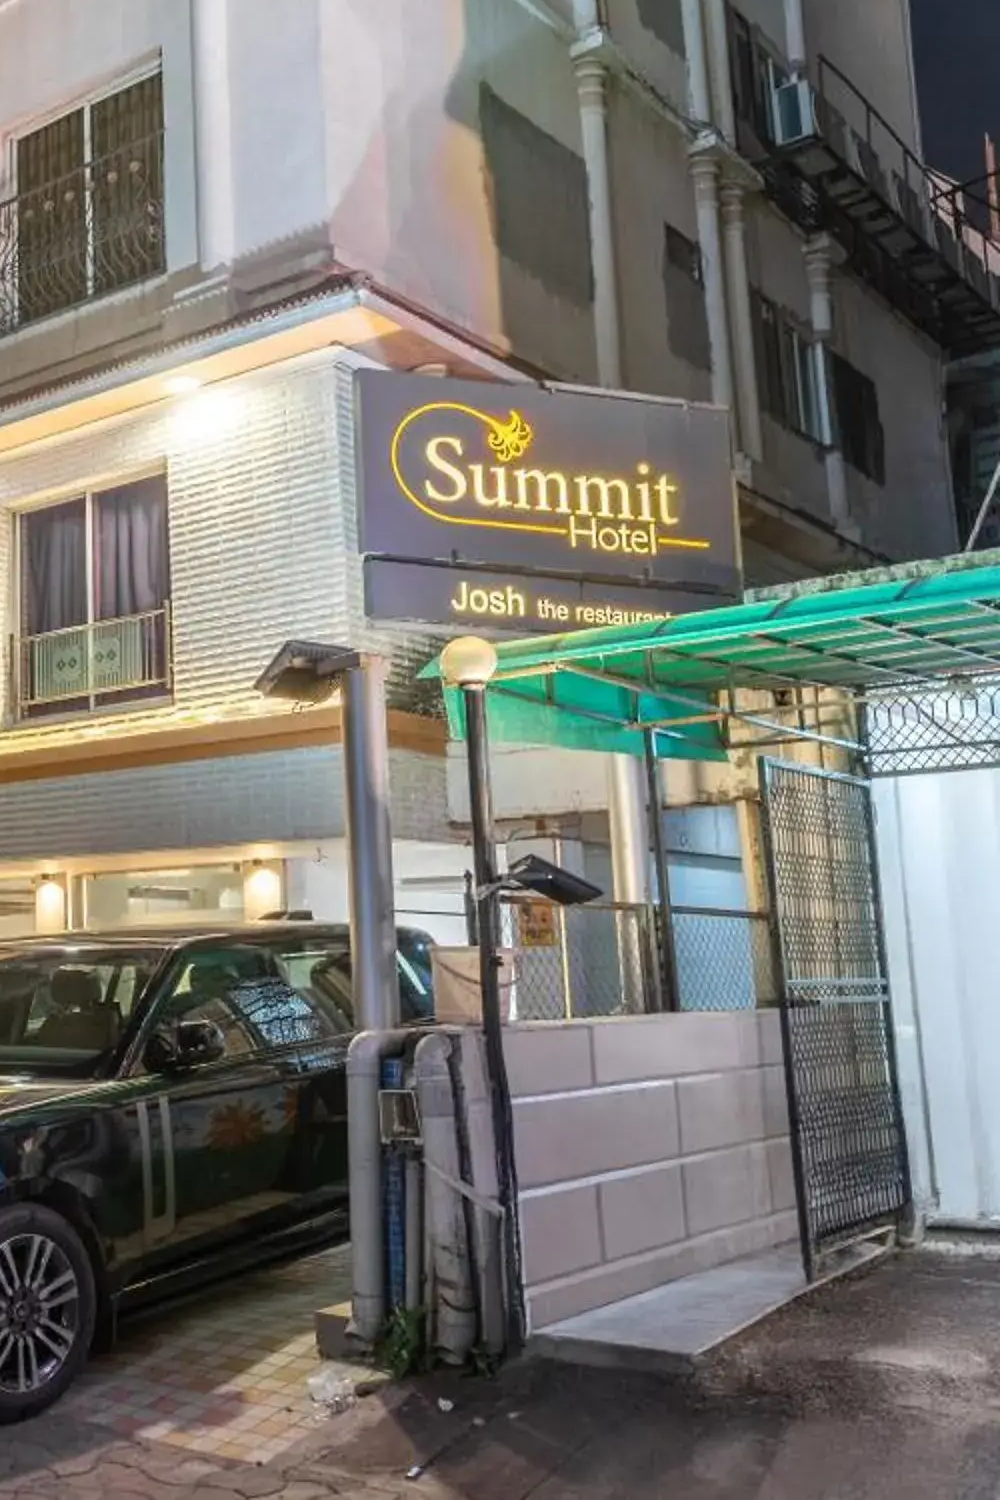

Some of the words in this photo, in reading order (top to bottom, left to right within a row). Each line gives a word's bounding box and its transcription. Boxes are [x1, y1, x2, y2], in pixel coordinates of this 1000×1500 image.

[424, 436, 680, 525] Summit
[569, 515, 657, 556] Hotel
[451, 581, 525, 617] Josh
[537, 598, 569, 620] the
